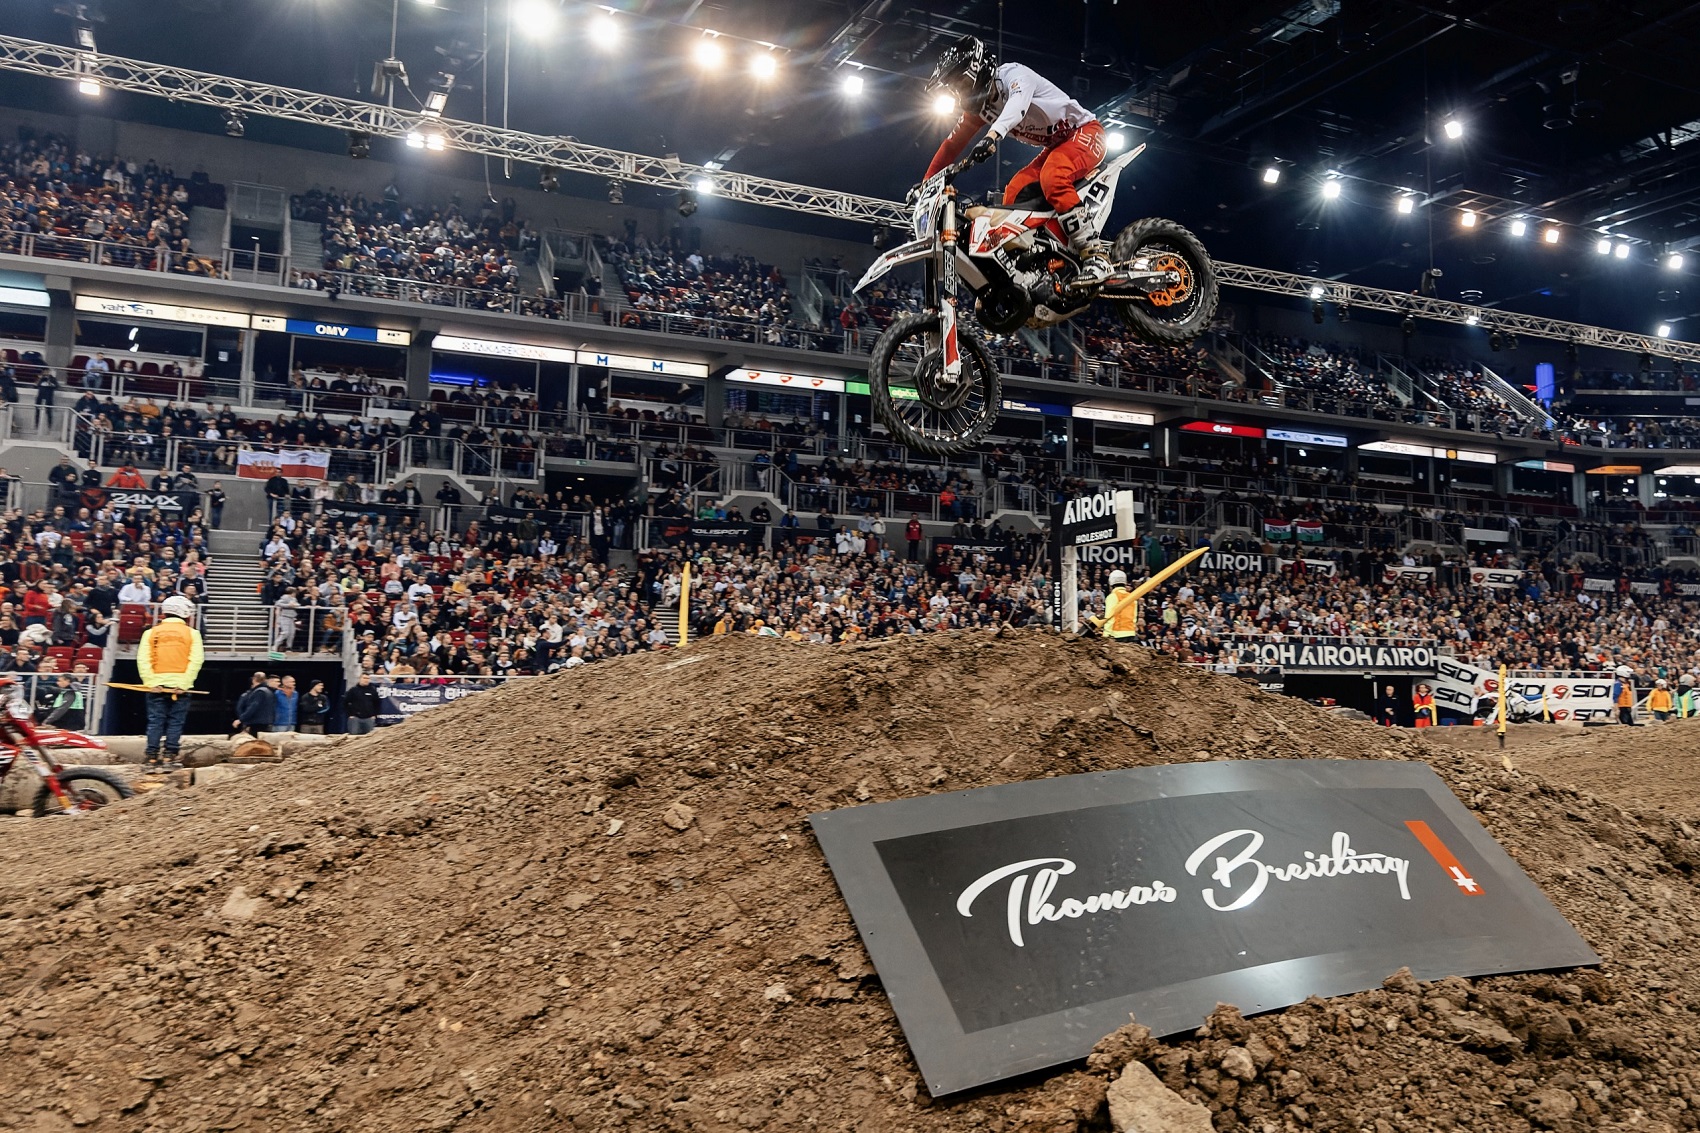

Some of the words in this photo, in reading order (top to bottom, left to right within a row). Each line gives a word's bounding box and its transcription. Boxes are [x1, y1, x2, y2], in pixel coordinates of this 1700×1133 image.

[315, 324, 349, 337] OMV
[110, 492, 180, 507] 24MX
[1062, 490, 1117, 526] AIROH
[1075, 528, 1114, 544] HOLESHOT
[1199, 552, 1262, 572] AIROH
[1299, 645, 1373, 666] AIROH
[1434, 687, 1473, 706] SID
[956, 857, 1177, 948] Thomas
[1185, 829, 1411, 912] Breitling
